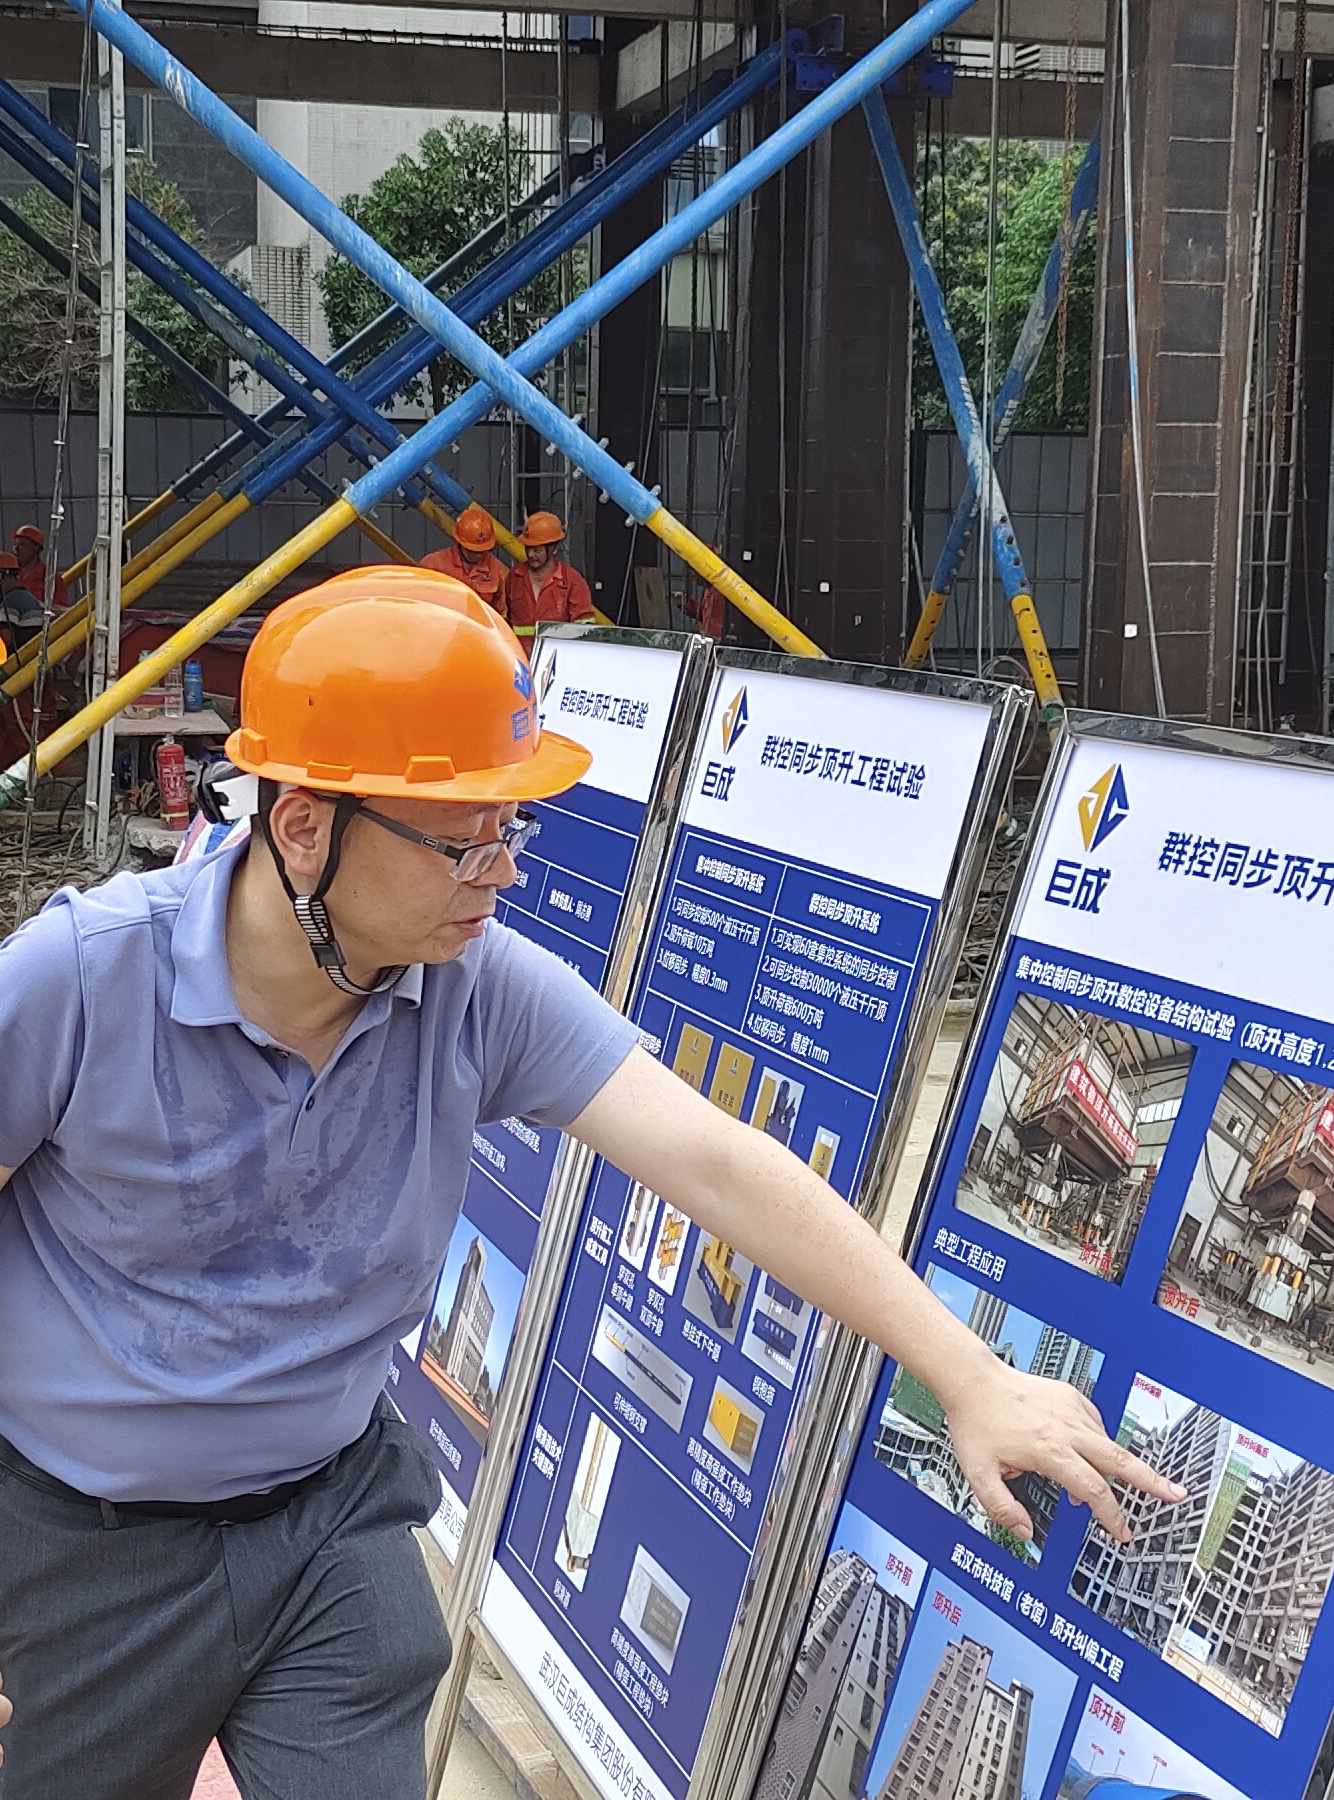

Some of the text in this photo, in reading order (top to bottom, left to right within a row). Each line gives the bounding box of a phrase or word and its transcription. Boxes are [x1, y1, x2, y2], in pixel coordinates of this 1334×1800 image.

[560, 687, 649, 729] 群控同步顶升工程试验
[701, 761, 737, 801] 巨成
[761, 735, 926, 800] 群控同步顶升工程试验
[695, 855, 766, 894] 集中控制同步顶升系统
[1045, 858, 1111, 914] 巨成
[808, 893, 881, 934] 群控同步顶升系统
[755, 984, 825, 1030] 3.顶升荷载600万吨
[933, 1227, 1007, 1282] 典型工程应用
[1162, 1286, 1201, 1319] 顶升后
[885, 1553, 914, 1587] 顶升前
[931, 1590, 963, 1627] 顶升后
[1088, 1693, 1125, 1735] 顶升前
